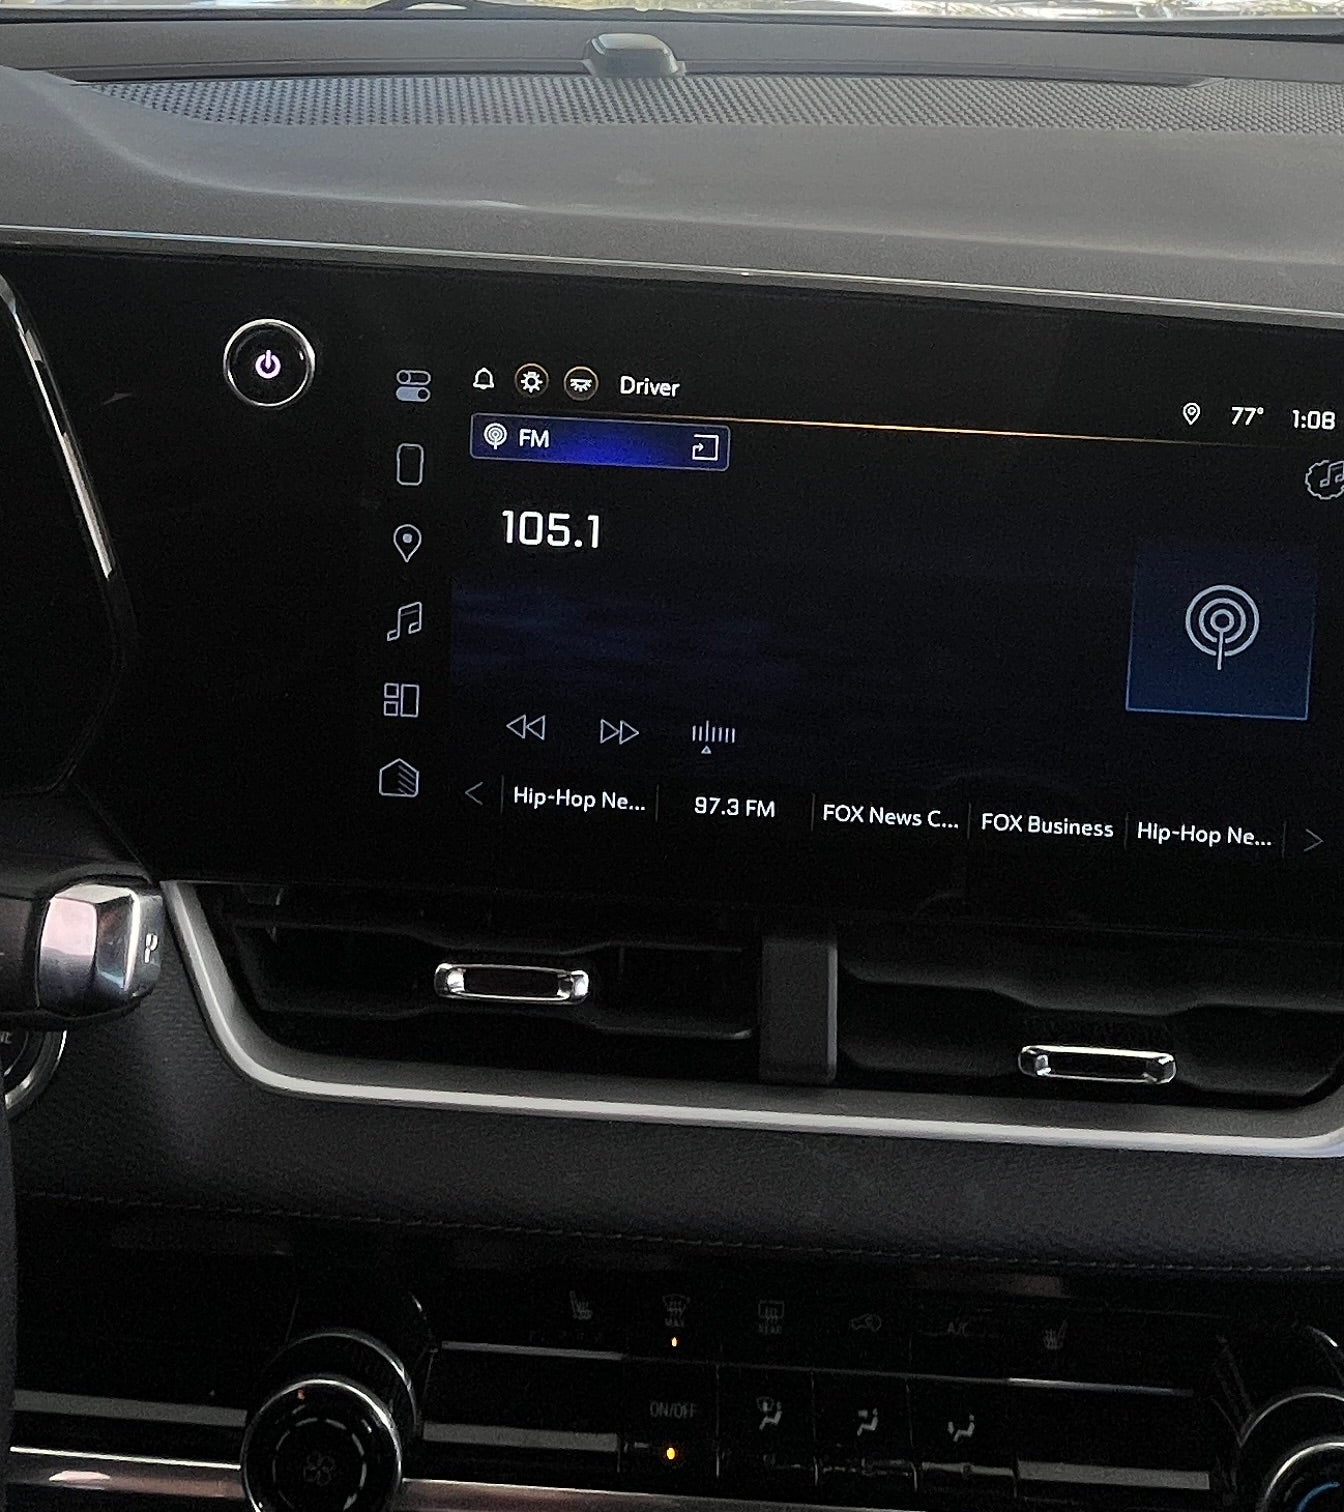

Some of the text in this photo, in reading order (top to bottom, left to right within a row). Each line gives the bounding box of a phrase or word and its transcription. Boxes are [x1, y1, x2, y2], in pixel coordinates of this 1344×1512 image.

[619, 375, 681, 399] Driver
[1230, 406, 1265, 426] 77°
[1291, 409, 1336, 430] 1:08
[518, 428, 551, 448] FM
[500, 509, 601, 549] 105.1
[513, 787, 646, 813] Hip-Hop Ne...
[693, 795, 776, 818] 97.3 FM
[822, 803, 960, 830] FOX News C...
[981, 812, 1114, 839] FOX Business
[1136, 820, 1272, 849] Hip-Hop Ne...
[649, 1399, 697, 1420] ON/OFF
